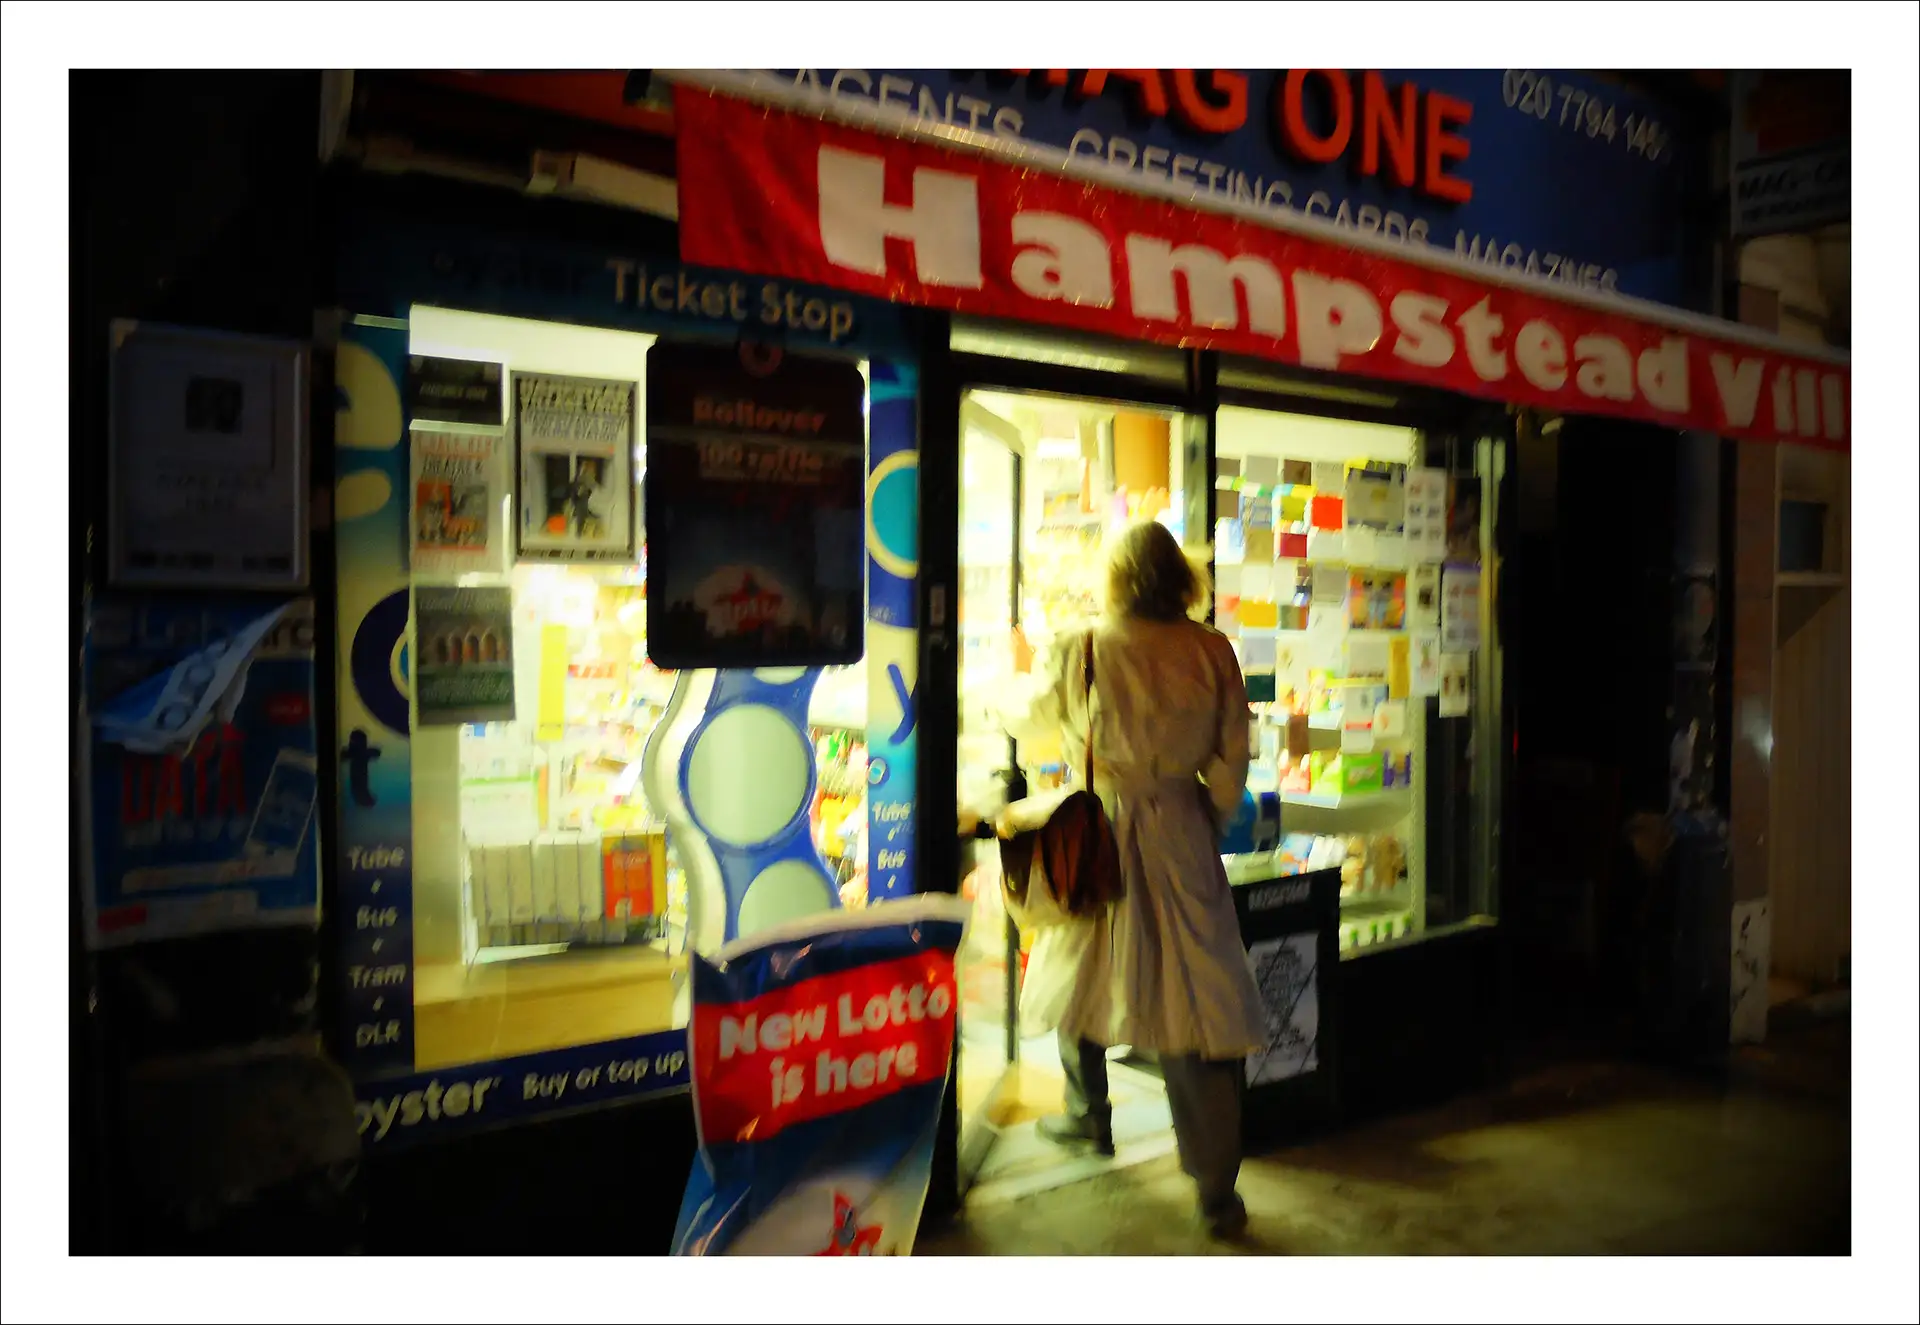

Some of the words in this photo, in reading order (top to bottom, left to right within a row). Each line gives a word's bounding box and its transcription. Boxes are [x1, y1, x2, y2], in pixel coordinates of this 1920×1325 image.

[1284, 69, 1474, 204] ONE
[1502, 69, 1551, 120] 020
[1557, 83, 1617, 144] 7794
[604, 256, 749, 322] Ticket
[759, 280, 857, 344] Stop
[816, 142, 1692, 414] Hampstead
[348, 846, 406, 871] Tube
[876, 848, 907, 871] Bus
[355, 904, 399, 931] Bus
[348, 962, 407, 989] Tram
[355, 1018, 402, 1049] DLR
[718, 1004, 828, 1062] New
[837, 981, 951, 1038] Lotto
[521, 1070, 571, 1101] Buy
[574, 1064, 604, 1091] or
[607, 1055, 650, 1085] top
[653, 1048, 686, 1079] up
[768, 1055, 806, 1110] is
[814, 1041, 918, 1097] here
